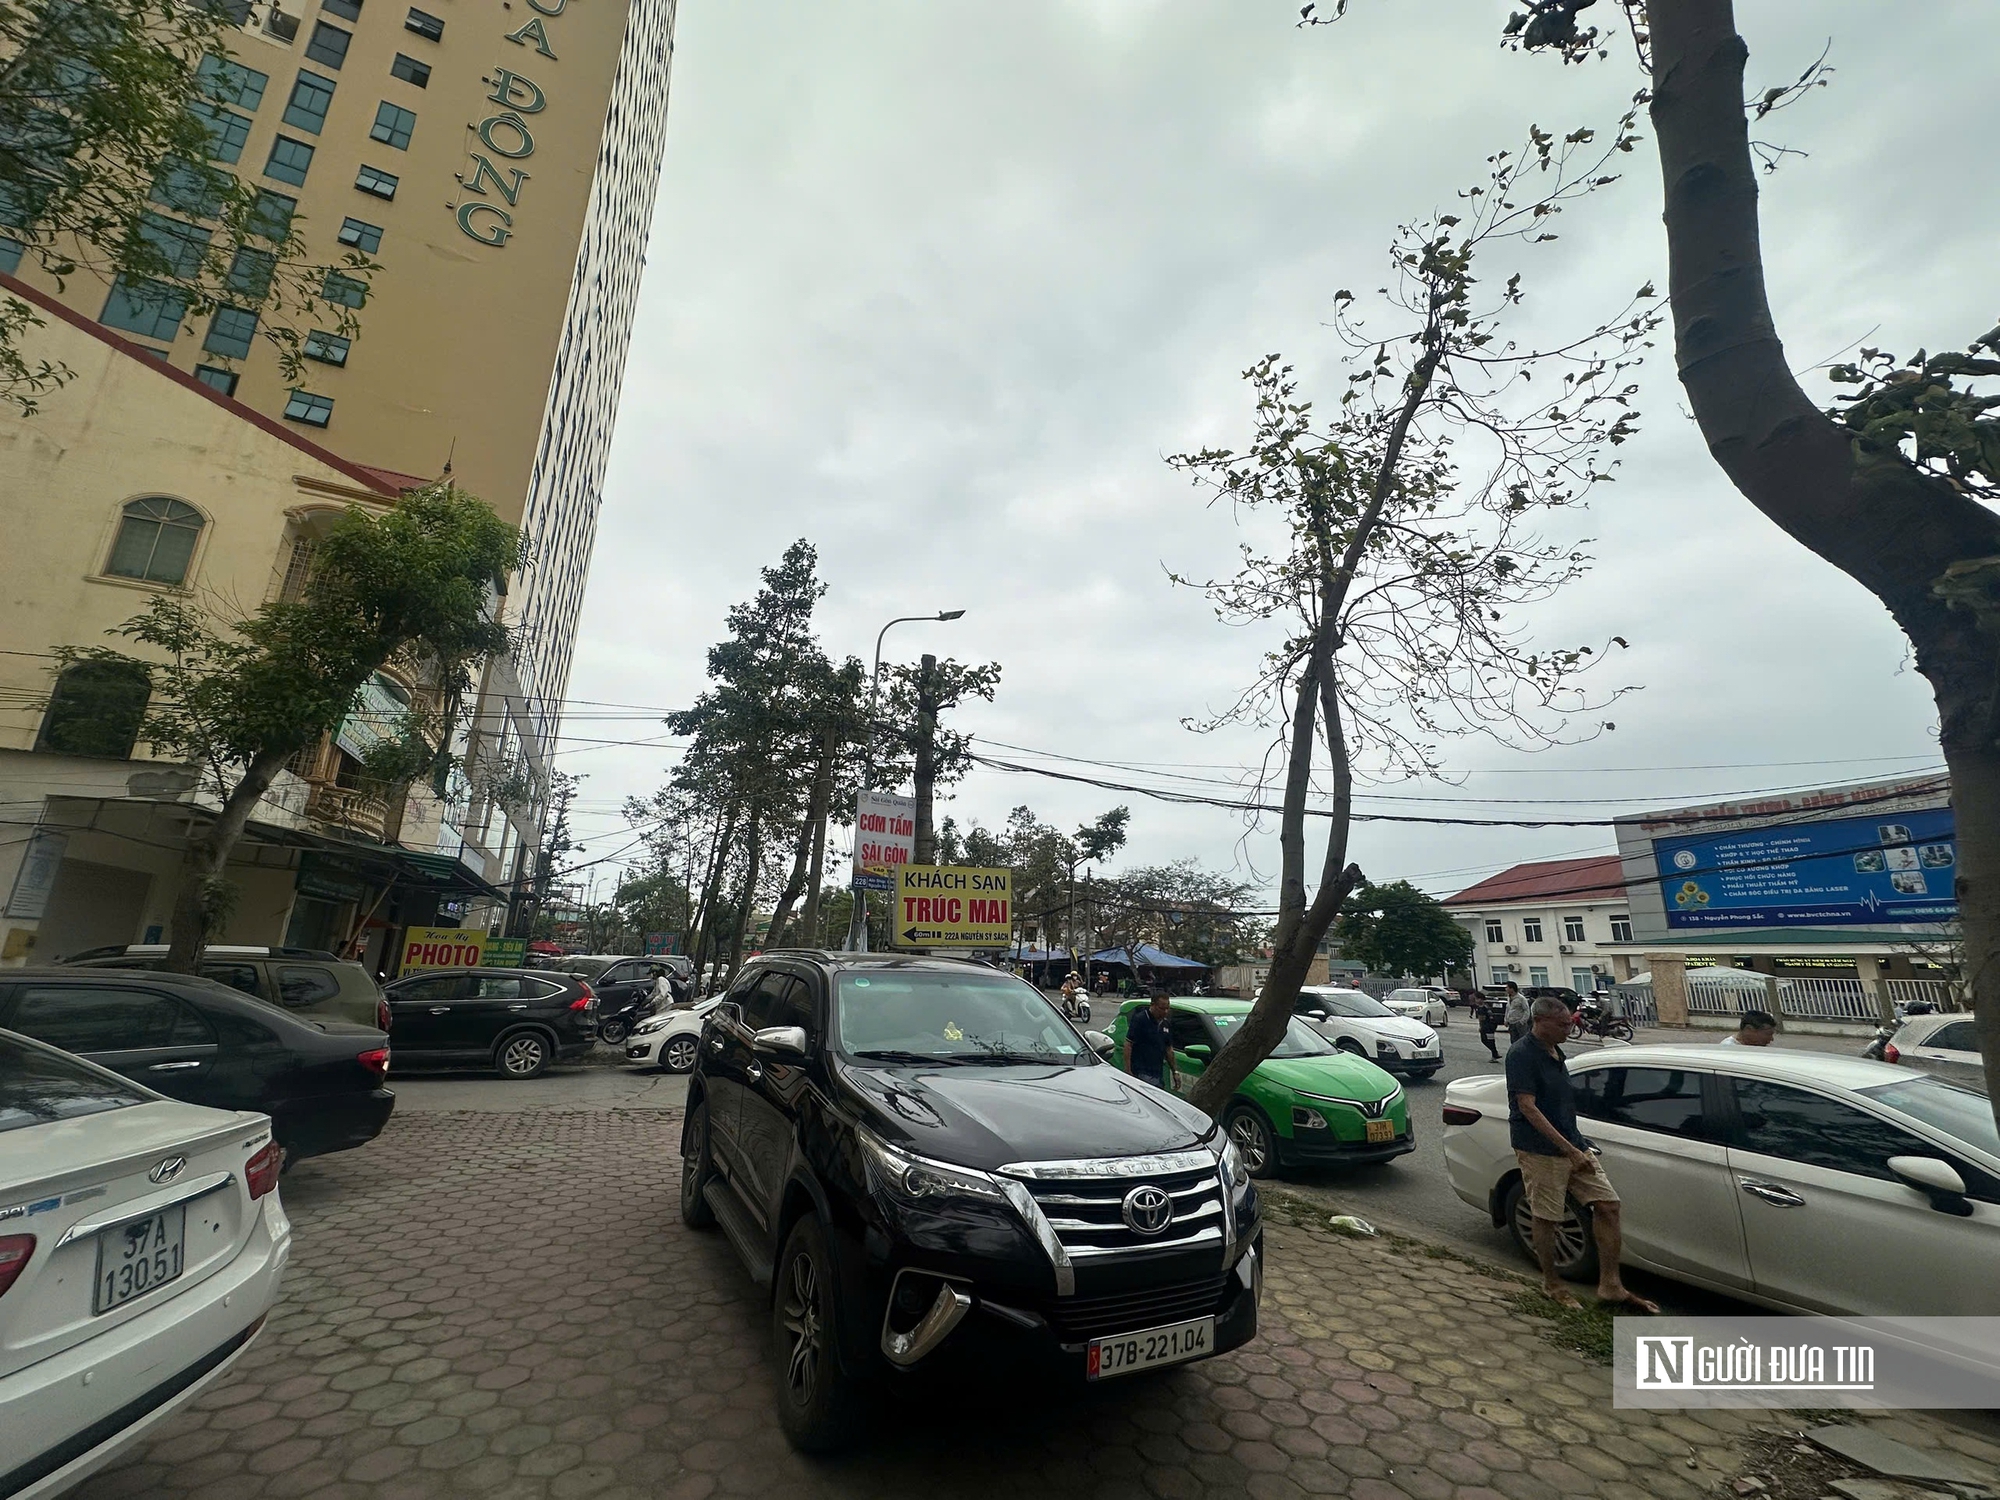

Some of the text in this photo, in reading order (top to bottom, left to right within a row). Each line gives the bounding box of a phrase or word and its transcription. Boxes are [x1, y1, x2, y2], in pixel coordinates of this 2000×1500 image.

[456, 0, 567, 247] A ĐÔNG
[860, 813, 913, 837] CƠM TẤM
[861, 841, 908, 864] SÀI GÒN
[855, 877, 867, 886] 228
[905, 869, 1006, 894] KHÁCH SẠN
[1727, 881, 1744, 889] PHẪU
[903, 894, 1007, 924] TRÚC MAI
[1752, 912, 1765, 920] Sắc
[424, 931, 448, 940] Hoa
[650, 934, 663, 946] VẬT
[945, 932, 960, 940] 222A
[961, 930, 984, 941] NGUYỄN
[985, 931, 992, 941] SỸ
[994, 931, 1009, 941] SÁCH
[405, 943, 480, 967] PHOTO
[1062, 1156, 1198, 1175] FORTUNER
[124, 1215, 166, 1259] 37A
[106, 1243, 179, 1306] 130.51
[1101, 1325, 1205, 1370] 37B-221.04
